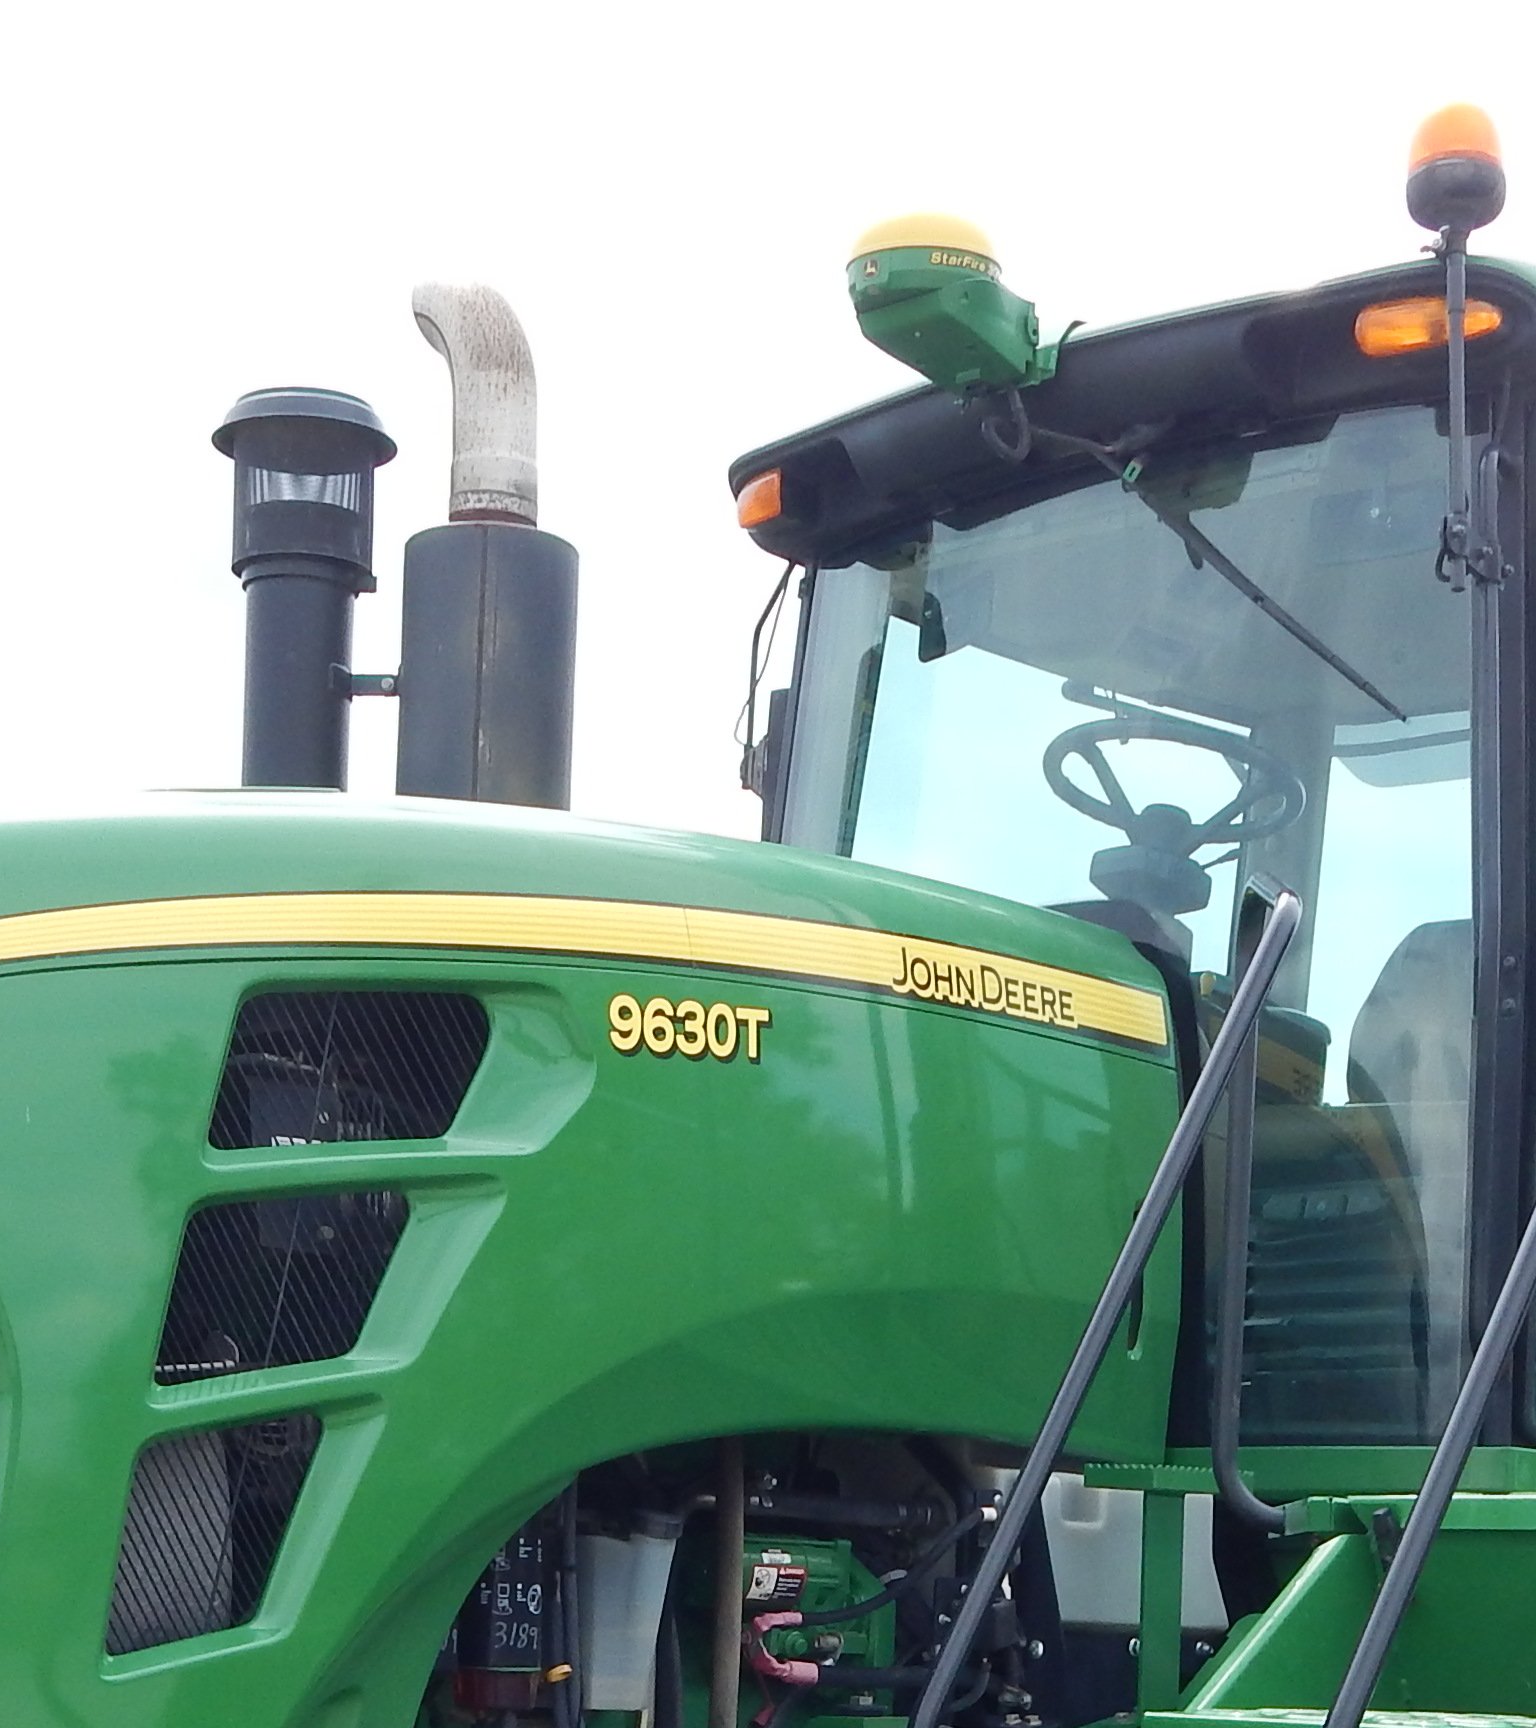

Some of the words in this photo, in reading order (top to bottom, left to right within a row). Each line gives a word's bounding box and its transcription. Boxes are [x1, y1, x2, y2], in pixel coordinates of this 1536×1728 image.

[930, 251, 986, 272] StarFire
[892, 946, 976, 1002] JOHN
[979, 963, 1076, 1024] DEERE
[608, 993, 772, 1062] 9630T
[493, 1621, 539, 1650] 3189
